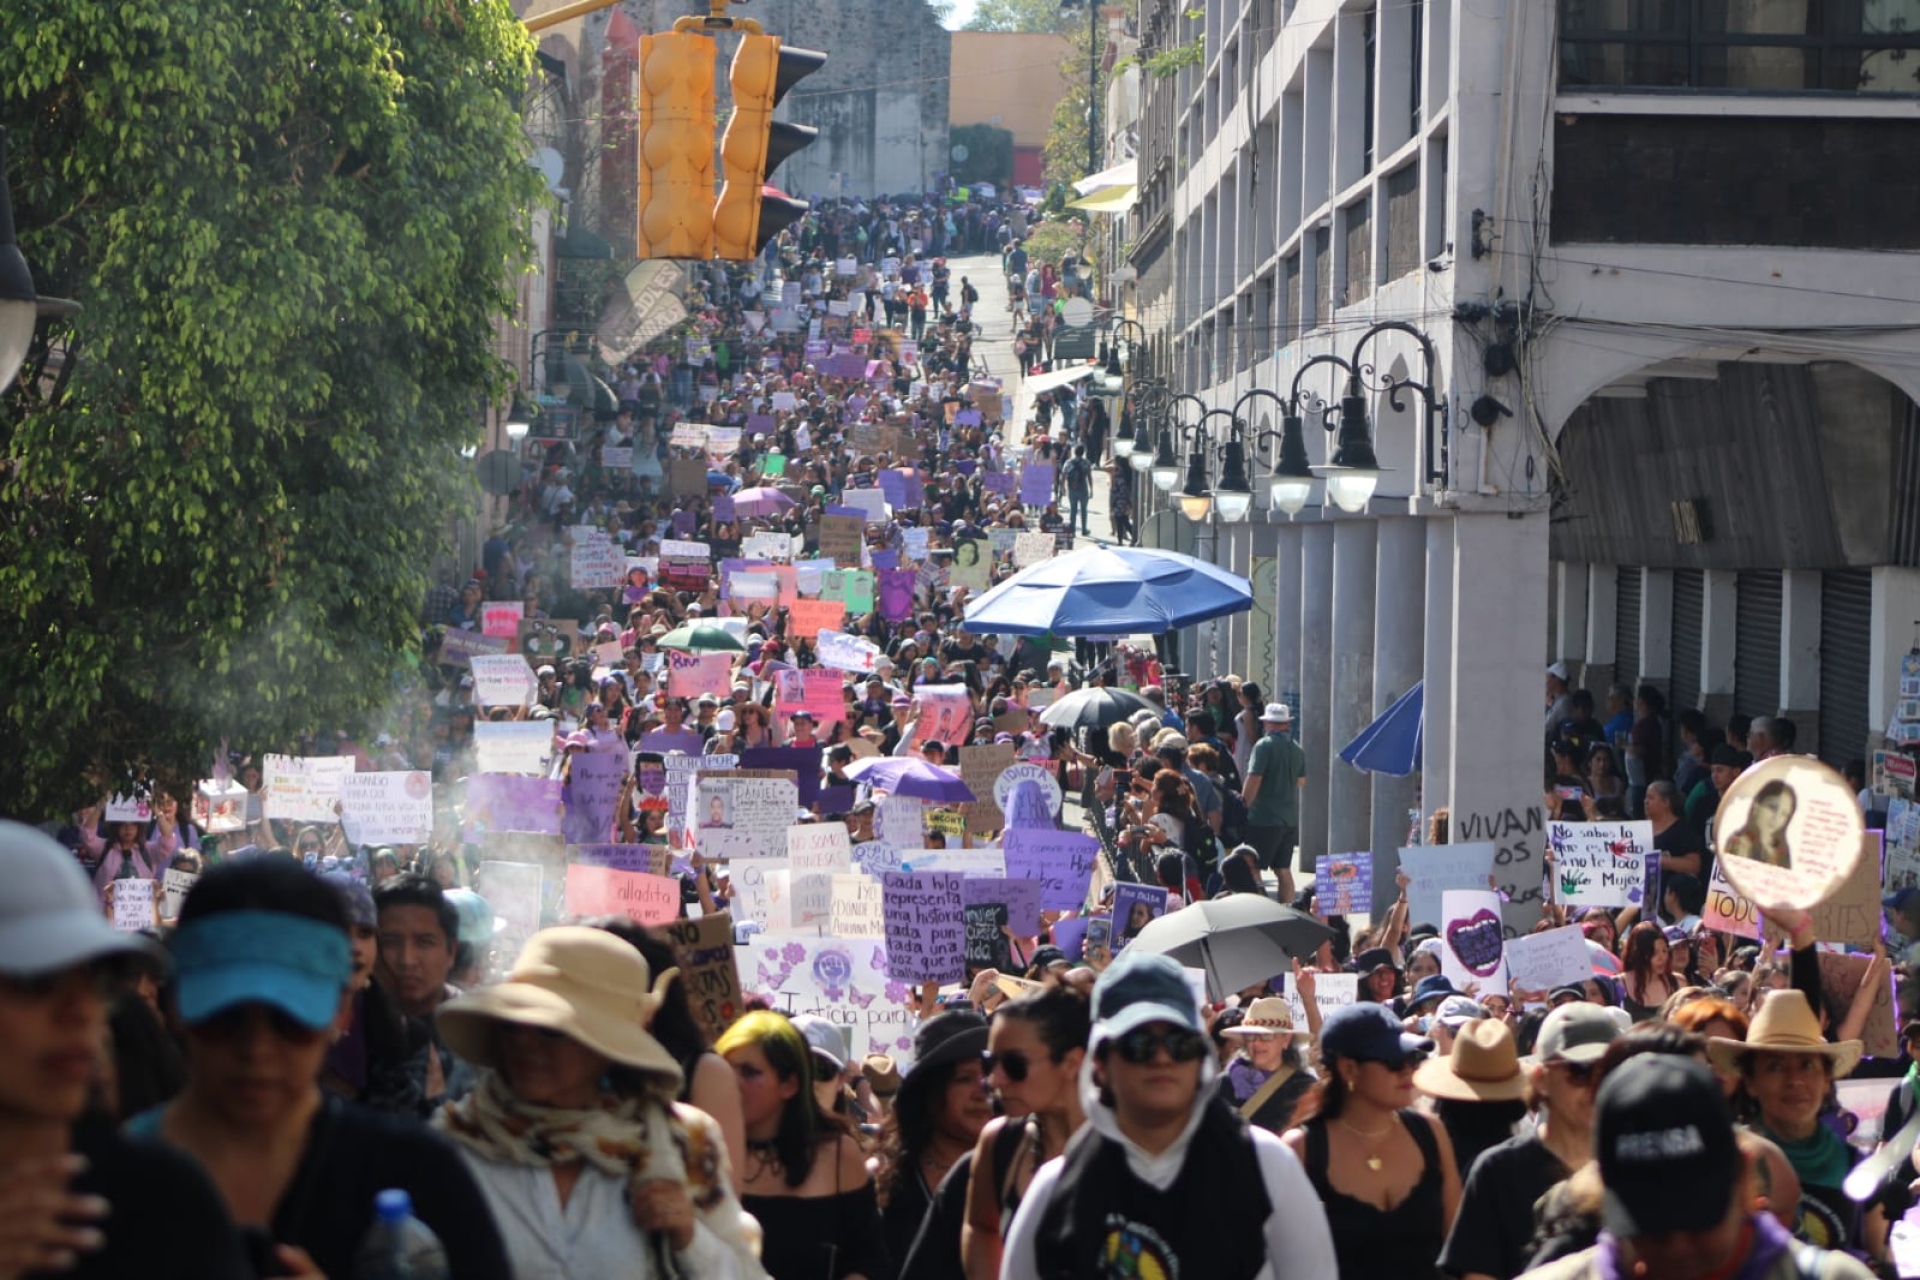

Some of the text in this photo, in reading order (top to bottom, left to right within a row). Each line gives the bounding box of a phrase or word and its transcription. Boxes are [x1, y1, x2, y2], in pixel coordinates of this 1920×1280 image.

[1002, 766, 1047, 783] IDIOTA
[1460, 806, 1542, 840] VIVAN
[1553, 824, 1633, 838] No sabes lo
[885, 872, 959, 891] Cada hilo
[1027, 868, 1064, 890] lbre
[884, 891, 962, 909] representa
[885, 906, 965, 924] una historia
[885, 922, 963, 943] cada pun-
[930, 942, 957, 956] una
[890, 955, 913, 966] voz
[920, 956, 945, 971] que
[890, 967, 963, 982] callaremos
[780, 992, 907, 1034] Jticia para
